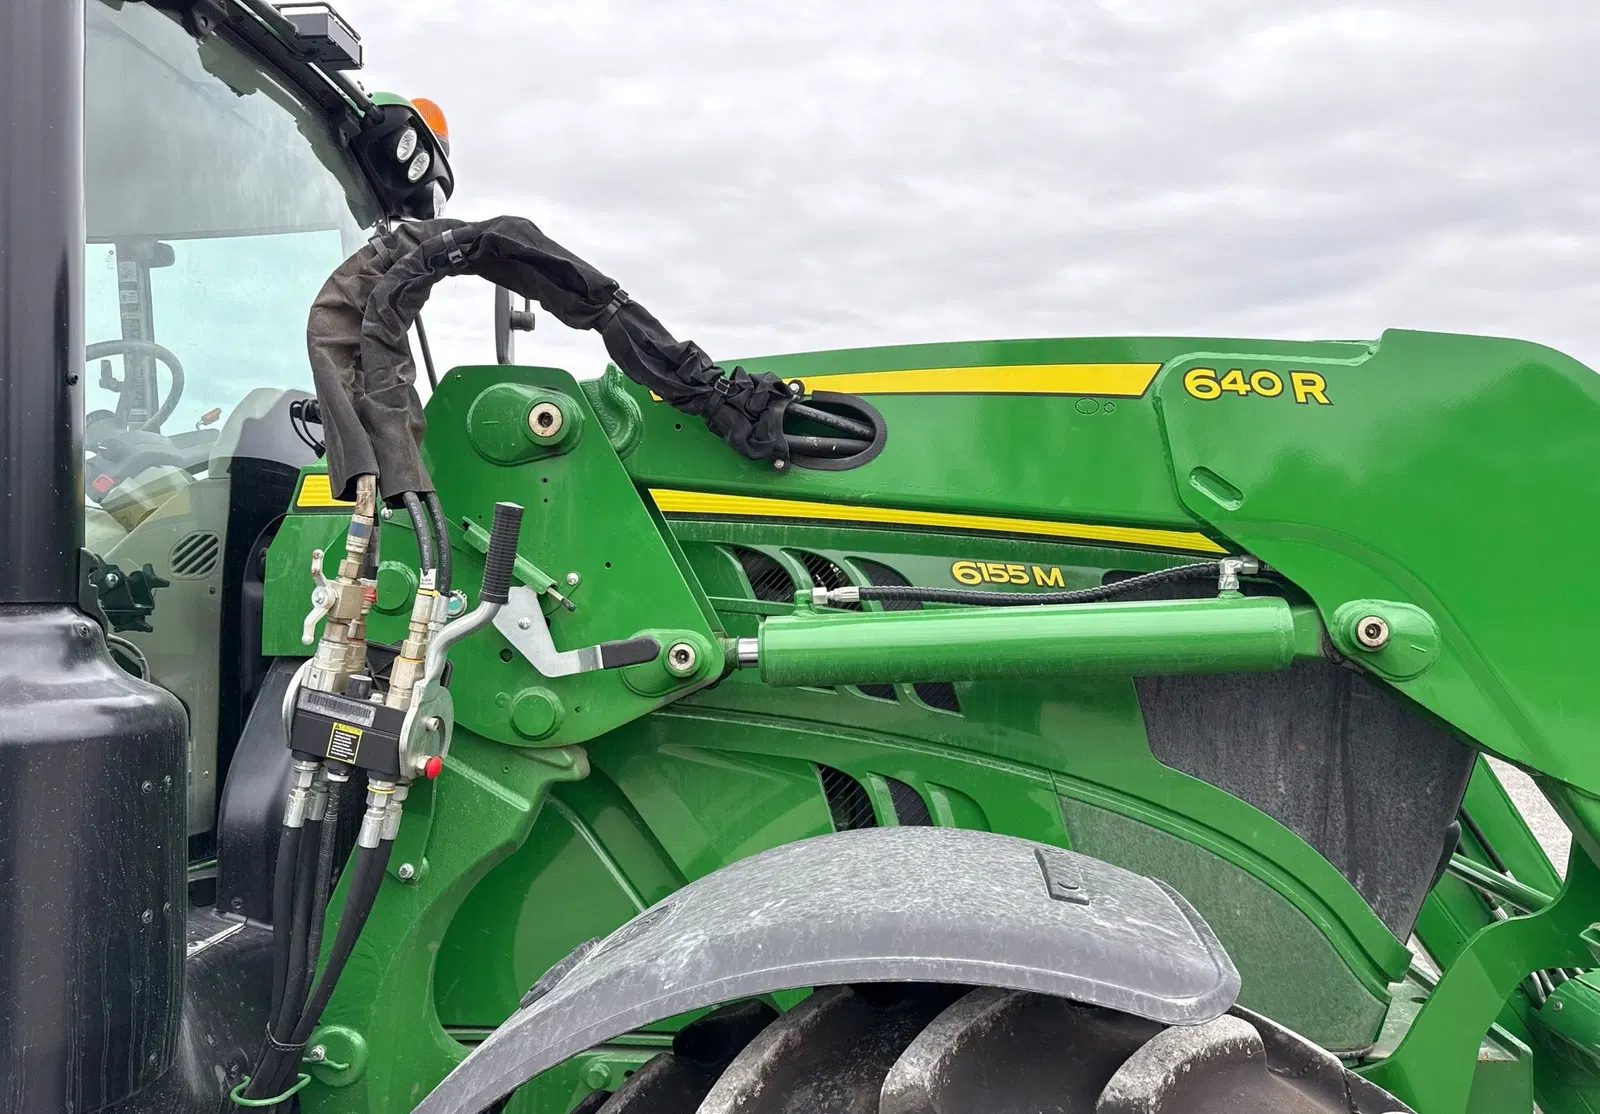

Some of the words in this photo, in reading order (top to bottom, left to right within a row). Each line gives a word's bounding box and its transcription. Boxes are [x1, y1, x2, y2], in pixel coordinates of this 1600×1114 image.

[1184, 368, 1284, 400] 640
[1290, 370, 1333, 405] R
[952, 560, 1030, 586] 6155
[1031, 565, 1065, 588] M
